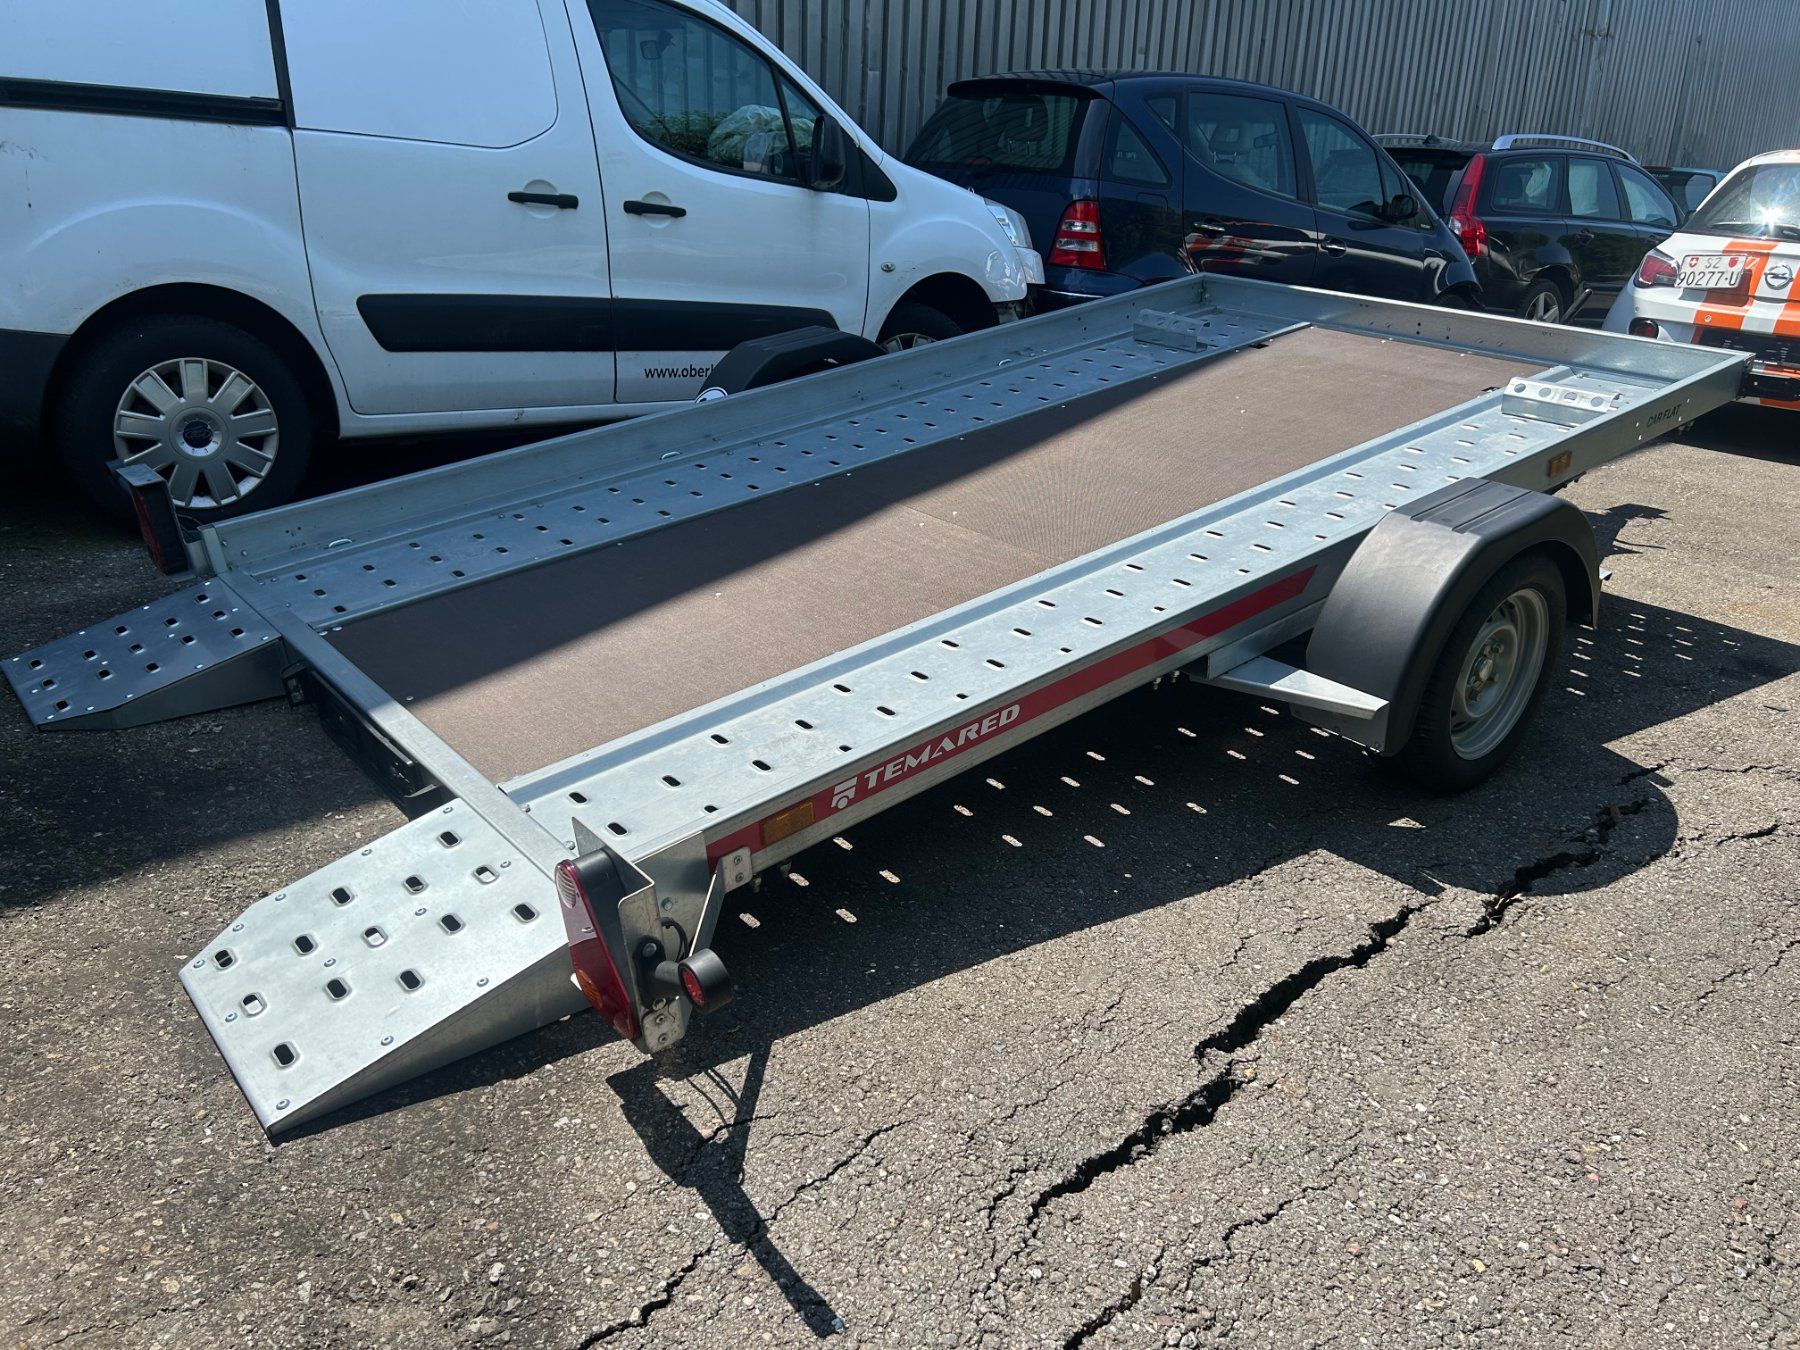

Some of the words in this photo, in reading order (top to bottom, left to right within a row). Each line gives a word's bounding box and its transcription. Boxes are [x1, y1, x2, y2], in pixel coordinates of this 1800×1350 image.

[1705, 257, 1722, 269] SZ
[1663, 404, 1682, 419] FLAT
[864, 704, 1021, 790] TEMARED
